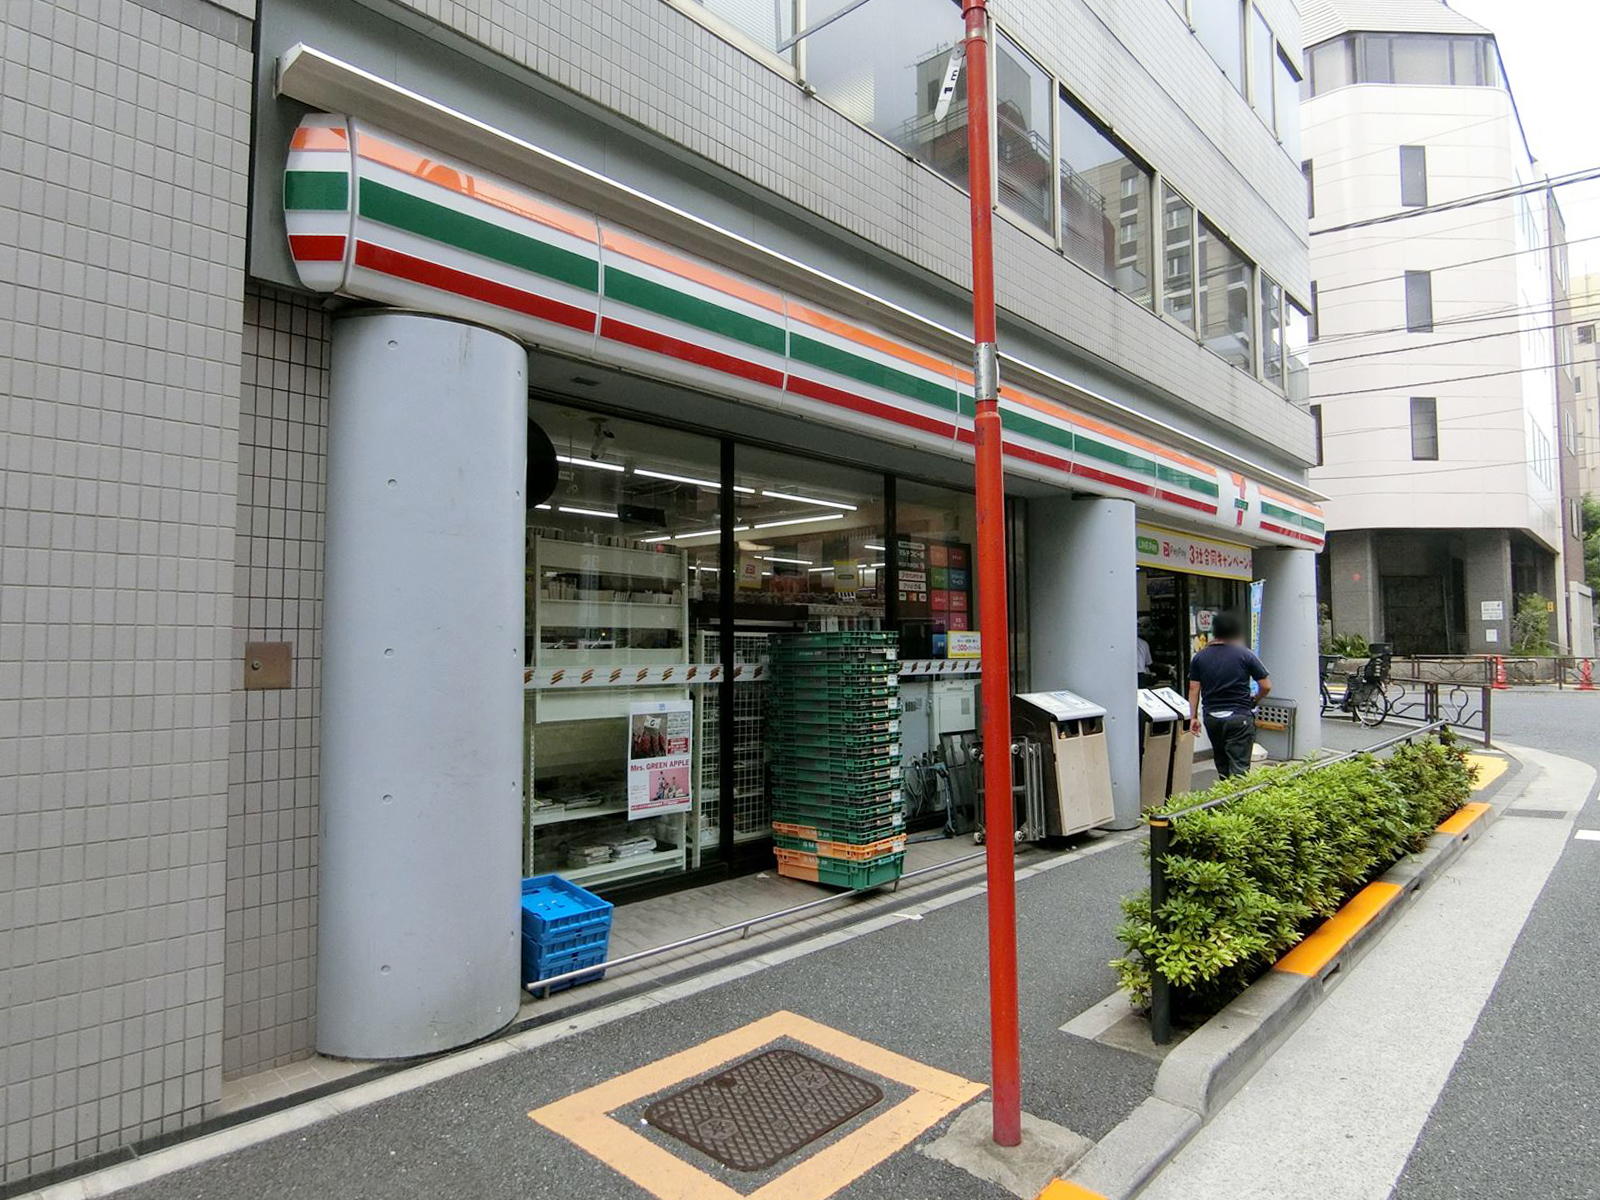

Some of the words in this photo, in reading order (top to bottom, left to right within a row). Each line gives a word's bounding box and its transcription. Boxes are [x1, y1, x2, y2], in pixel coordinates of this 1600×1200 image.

[631, 763, 645, 772] Mrs.
[646, 761, 668, 771] GREEN
[669, 758, 690, 768] APPLE
